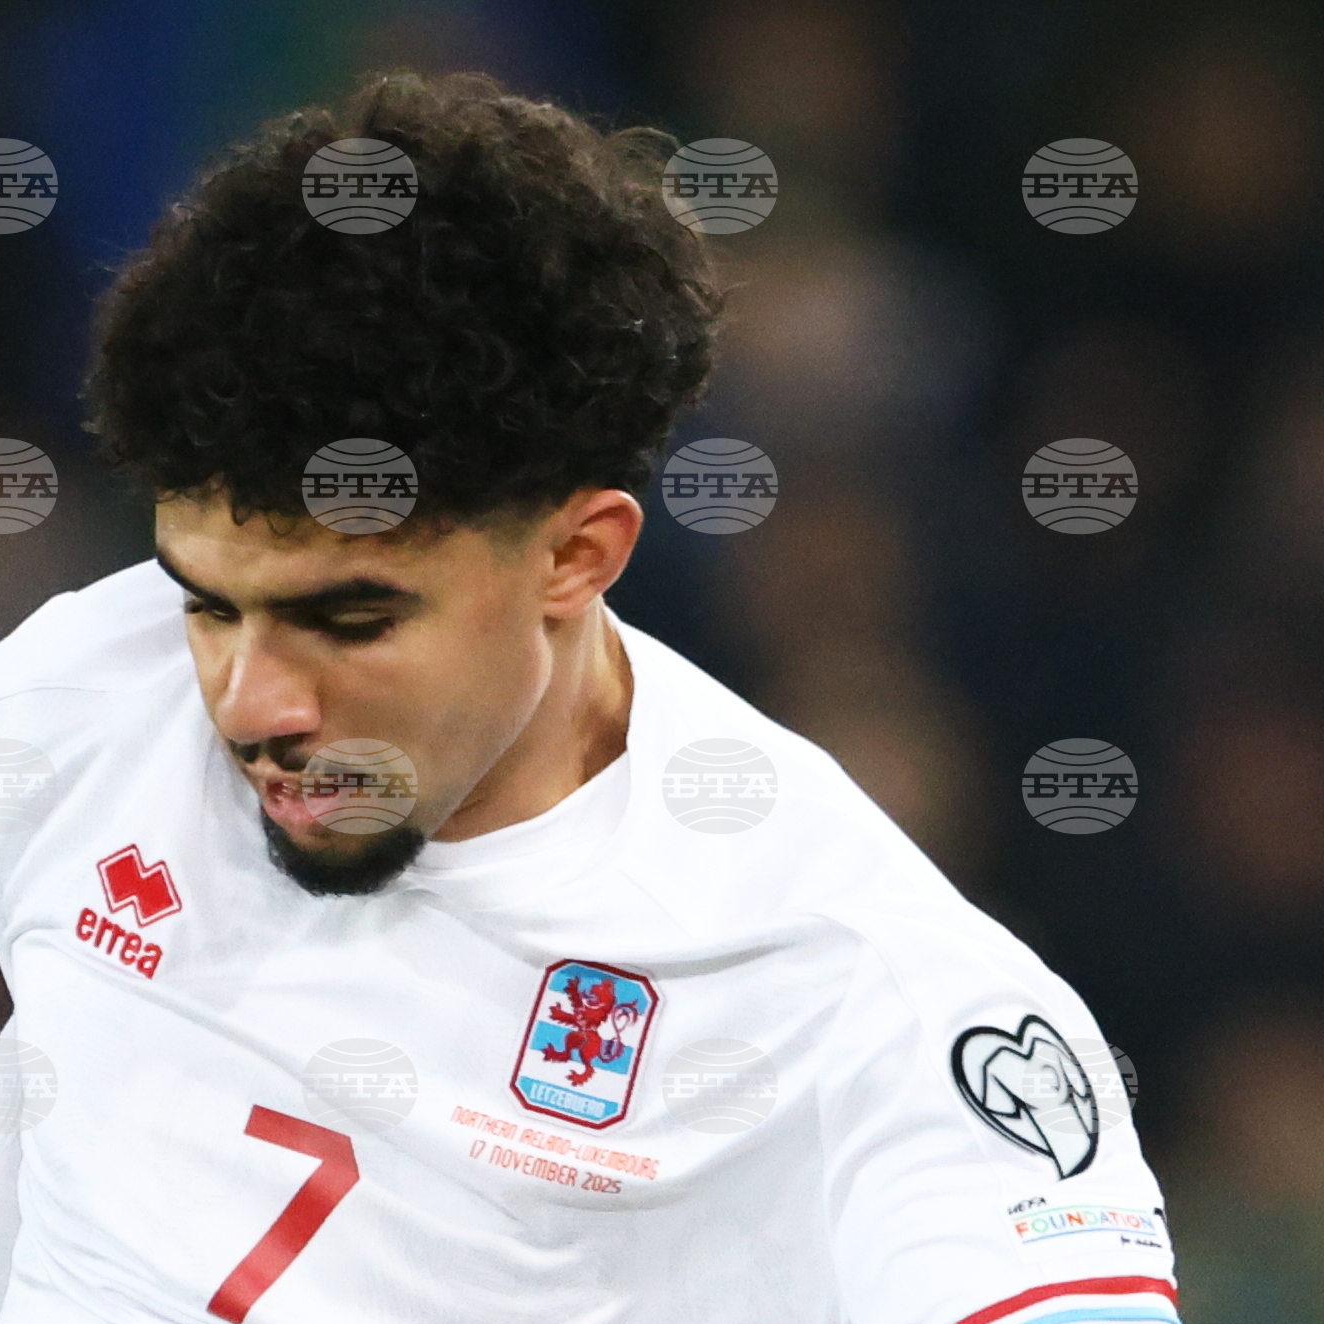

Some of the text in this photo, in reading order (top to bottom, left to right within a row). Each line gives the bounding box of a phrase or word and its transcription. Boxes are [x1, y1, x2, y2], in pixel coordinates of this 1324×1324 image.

[76, 907, 163, 980] errea
[450, 1105, 517, 1140] NORTHERN
[469, 1139, 624, 1194] 17 NOVEMBER 2025
[1014, 1211, 1155, 1239] FOUNDATION
